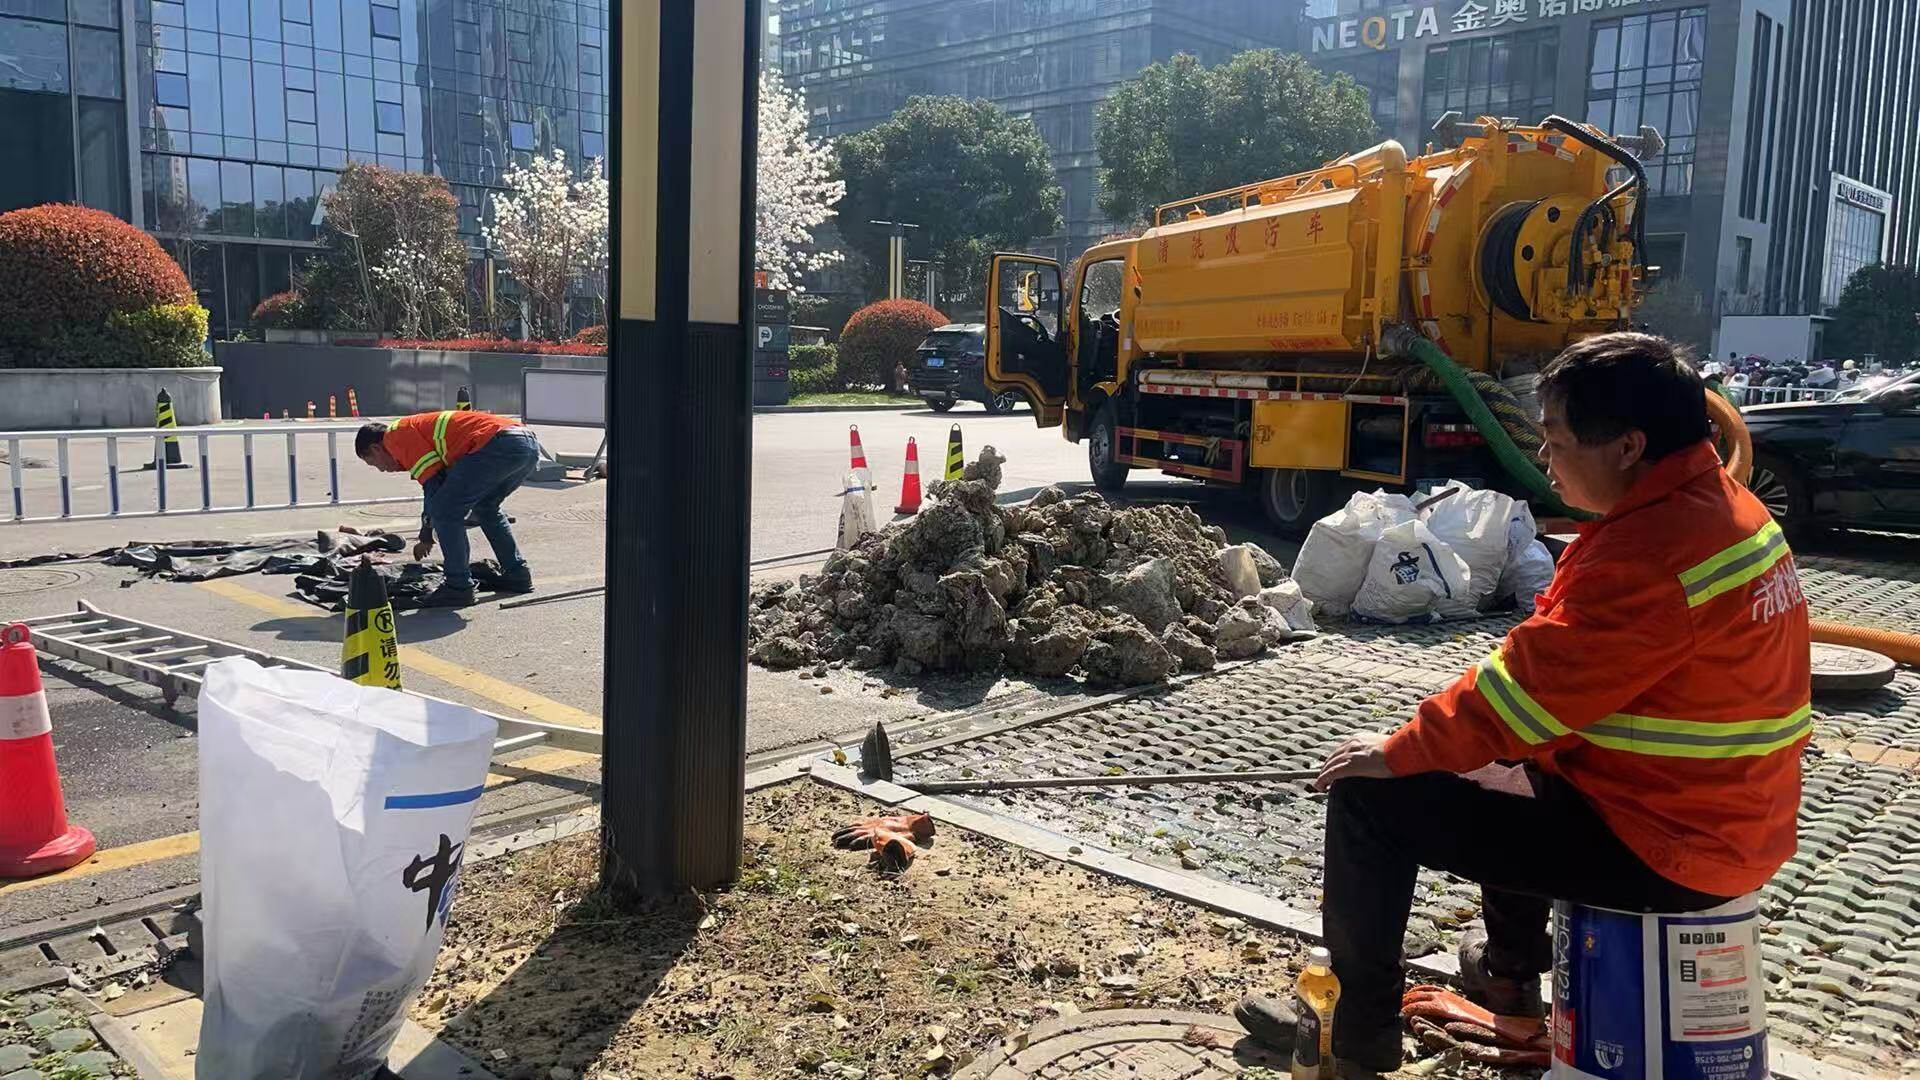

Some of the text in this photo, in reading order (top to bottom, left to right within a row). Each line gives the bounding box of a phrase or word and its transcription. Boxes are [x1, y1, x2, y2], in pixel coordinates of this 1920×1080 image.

[1311, 8, 1440, 53] NEQTA
[1158, 210, 1324, 264] 清洗吸污车
[379, 636, 402, 690] 请勿
